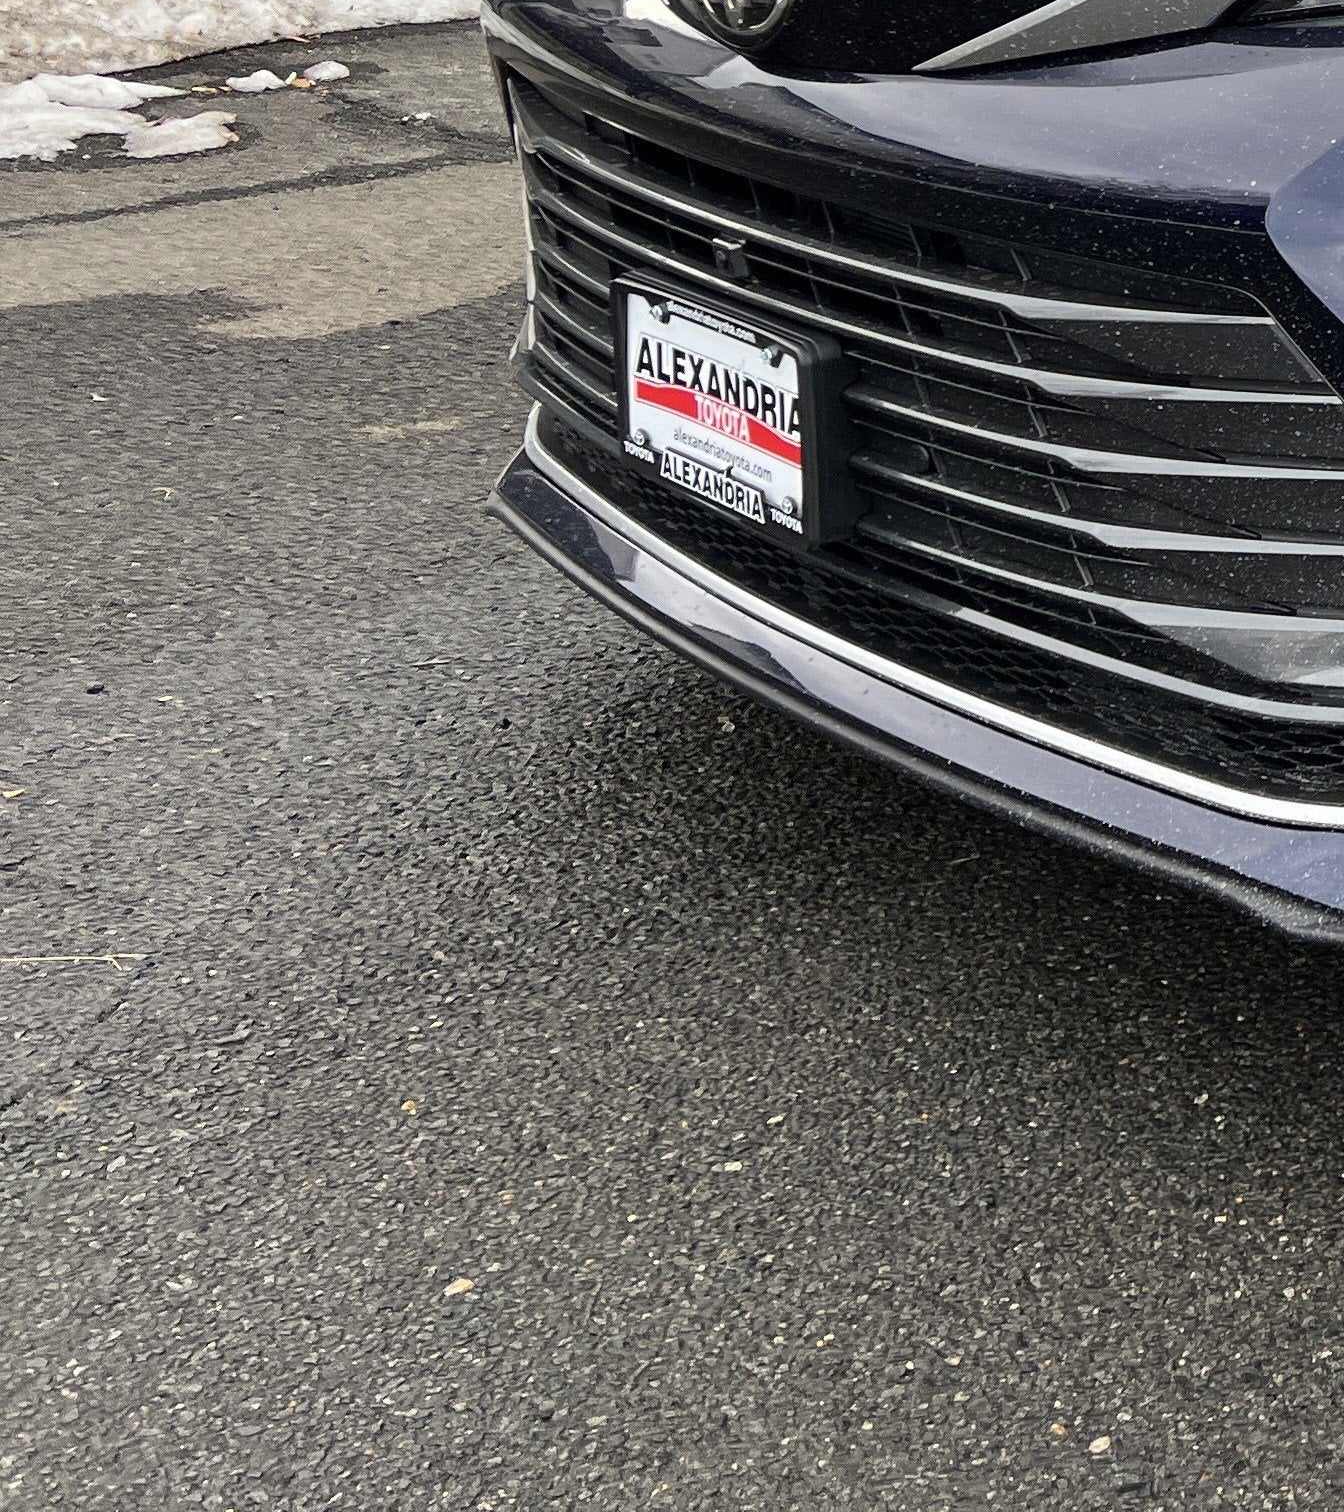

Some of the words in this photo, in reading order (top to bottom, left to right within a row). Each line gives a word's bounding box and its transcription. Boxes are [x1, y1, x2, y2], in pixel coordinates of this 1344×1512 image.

[636, 336, 800, 435] ALEXANDRIA
[694, 393, 751, 442] TOYOTA
[662, 451, 764, 523] ALEXANDRIA
[770, 507, 803, 534] TOYOTA
